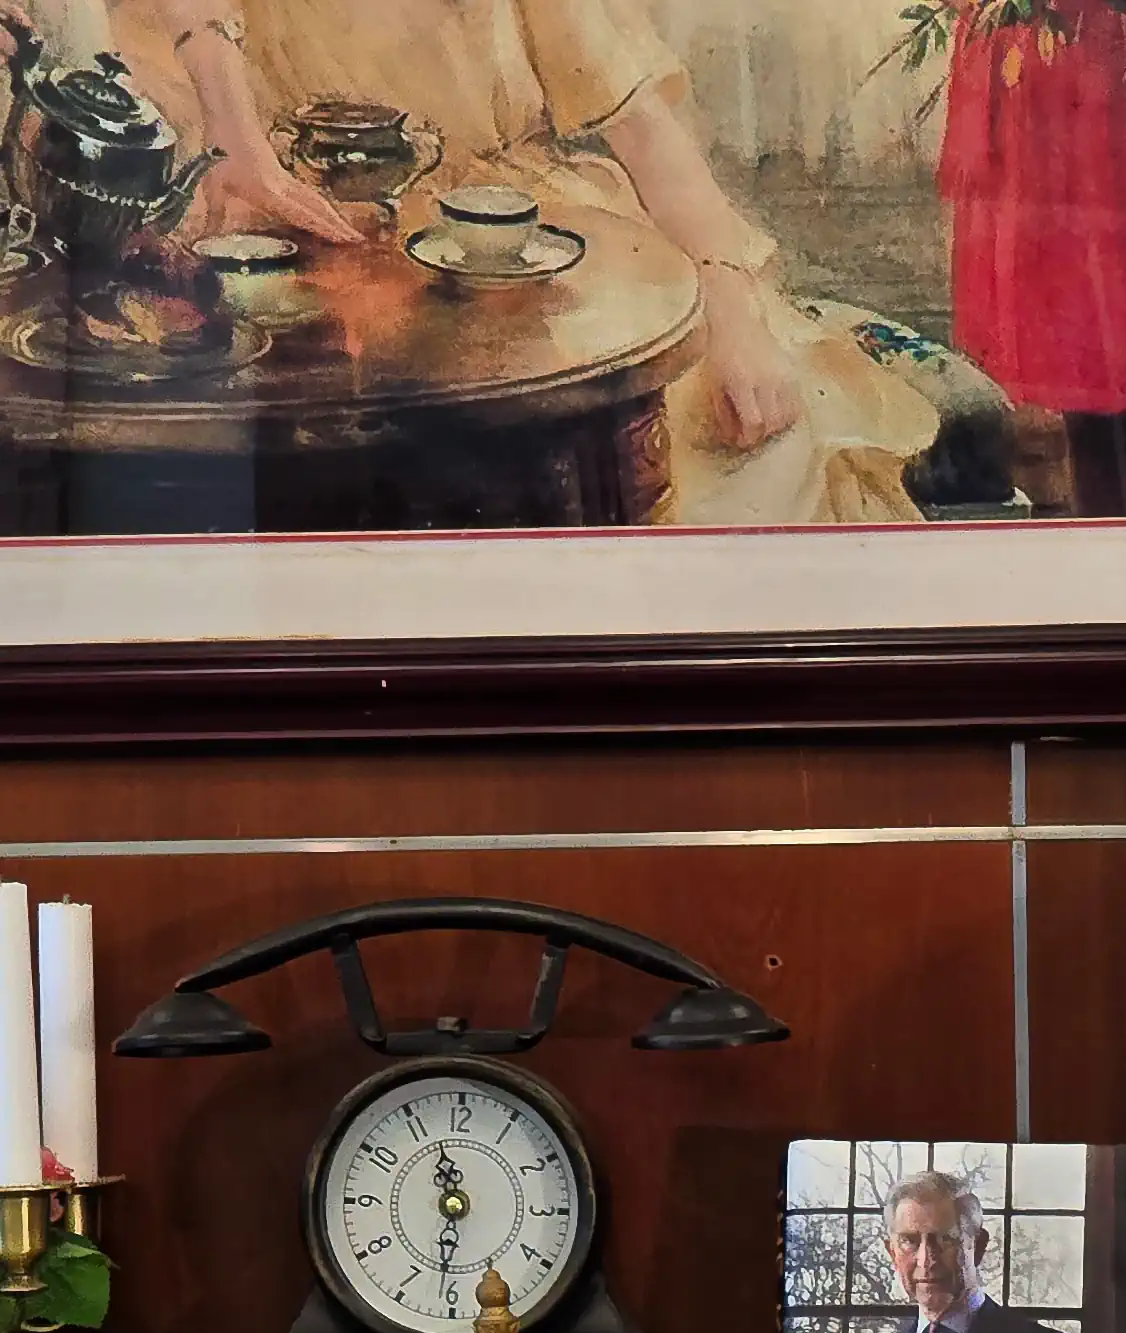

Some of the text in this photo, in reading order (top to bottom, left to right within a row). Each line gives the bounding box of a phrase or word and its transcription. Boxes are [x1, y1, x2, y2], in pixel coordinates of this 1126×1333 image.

[406, 1115, 428, 1142] 11
[450, 1106, 473, 1133] 12
[496, 1122, 512, 1144] 1
[369, 1145, 399, 1173] 10
[519, 1158, 547, 1177] 2
[357, 1194, 384, 1208] 9
[529, 1204, 556, 1217] 3
[367, 1235, 392, 1254] 8
[519, 1243, 540, 1262] 4
[400, 1264, 422, 1287] 7
[446, 1281, 459, 1305] 6
